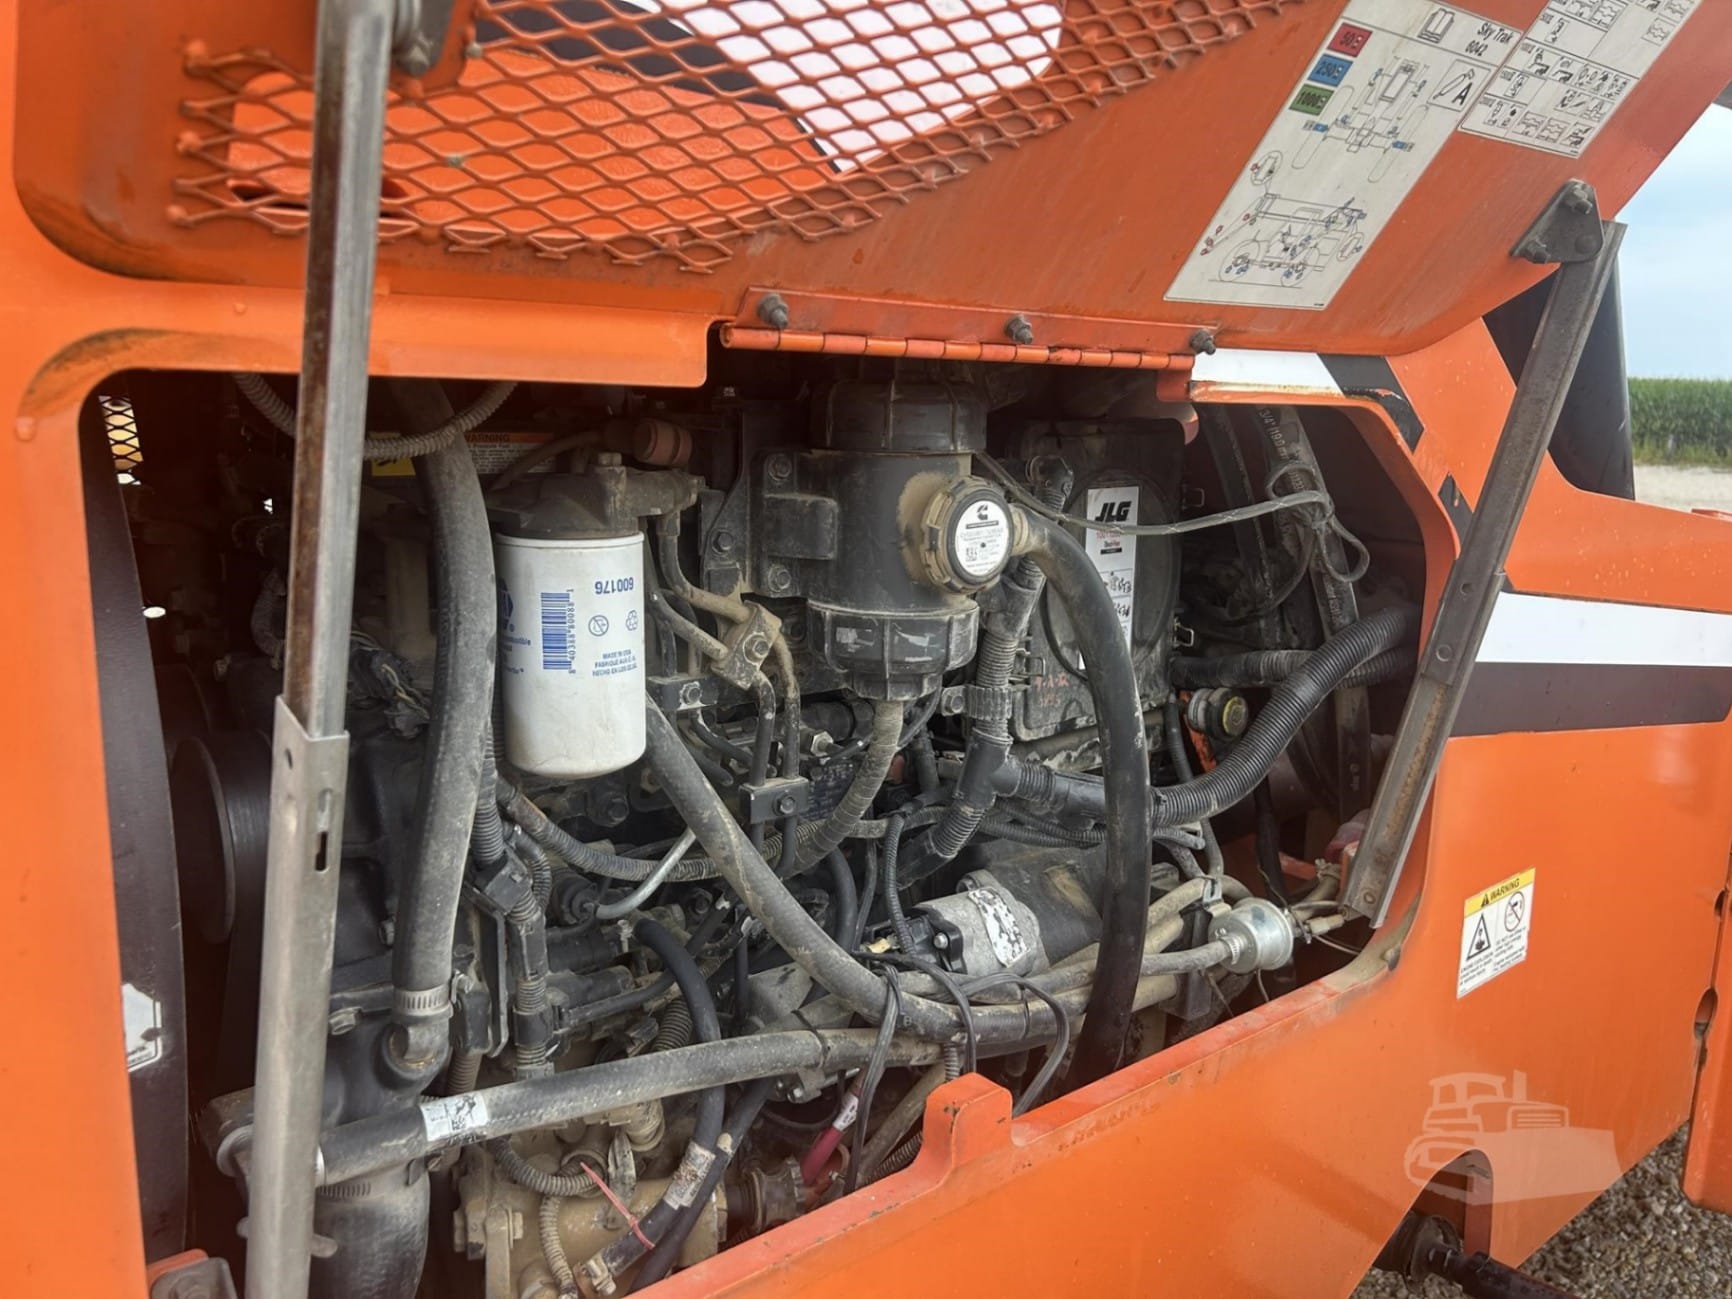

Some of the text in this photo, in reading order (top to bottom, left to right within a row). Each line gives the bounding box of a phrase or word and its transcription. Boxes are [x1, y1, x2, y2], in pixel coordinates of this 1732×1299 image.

[1451, 82, 1473, 105] A
[1095, 501, 1132, 523] JLG
[594, 577, 634, 595] 600176
[1490, 878, 1520, 901] WARNING
